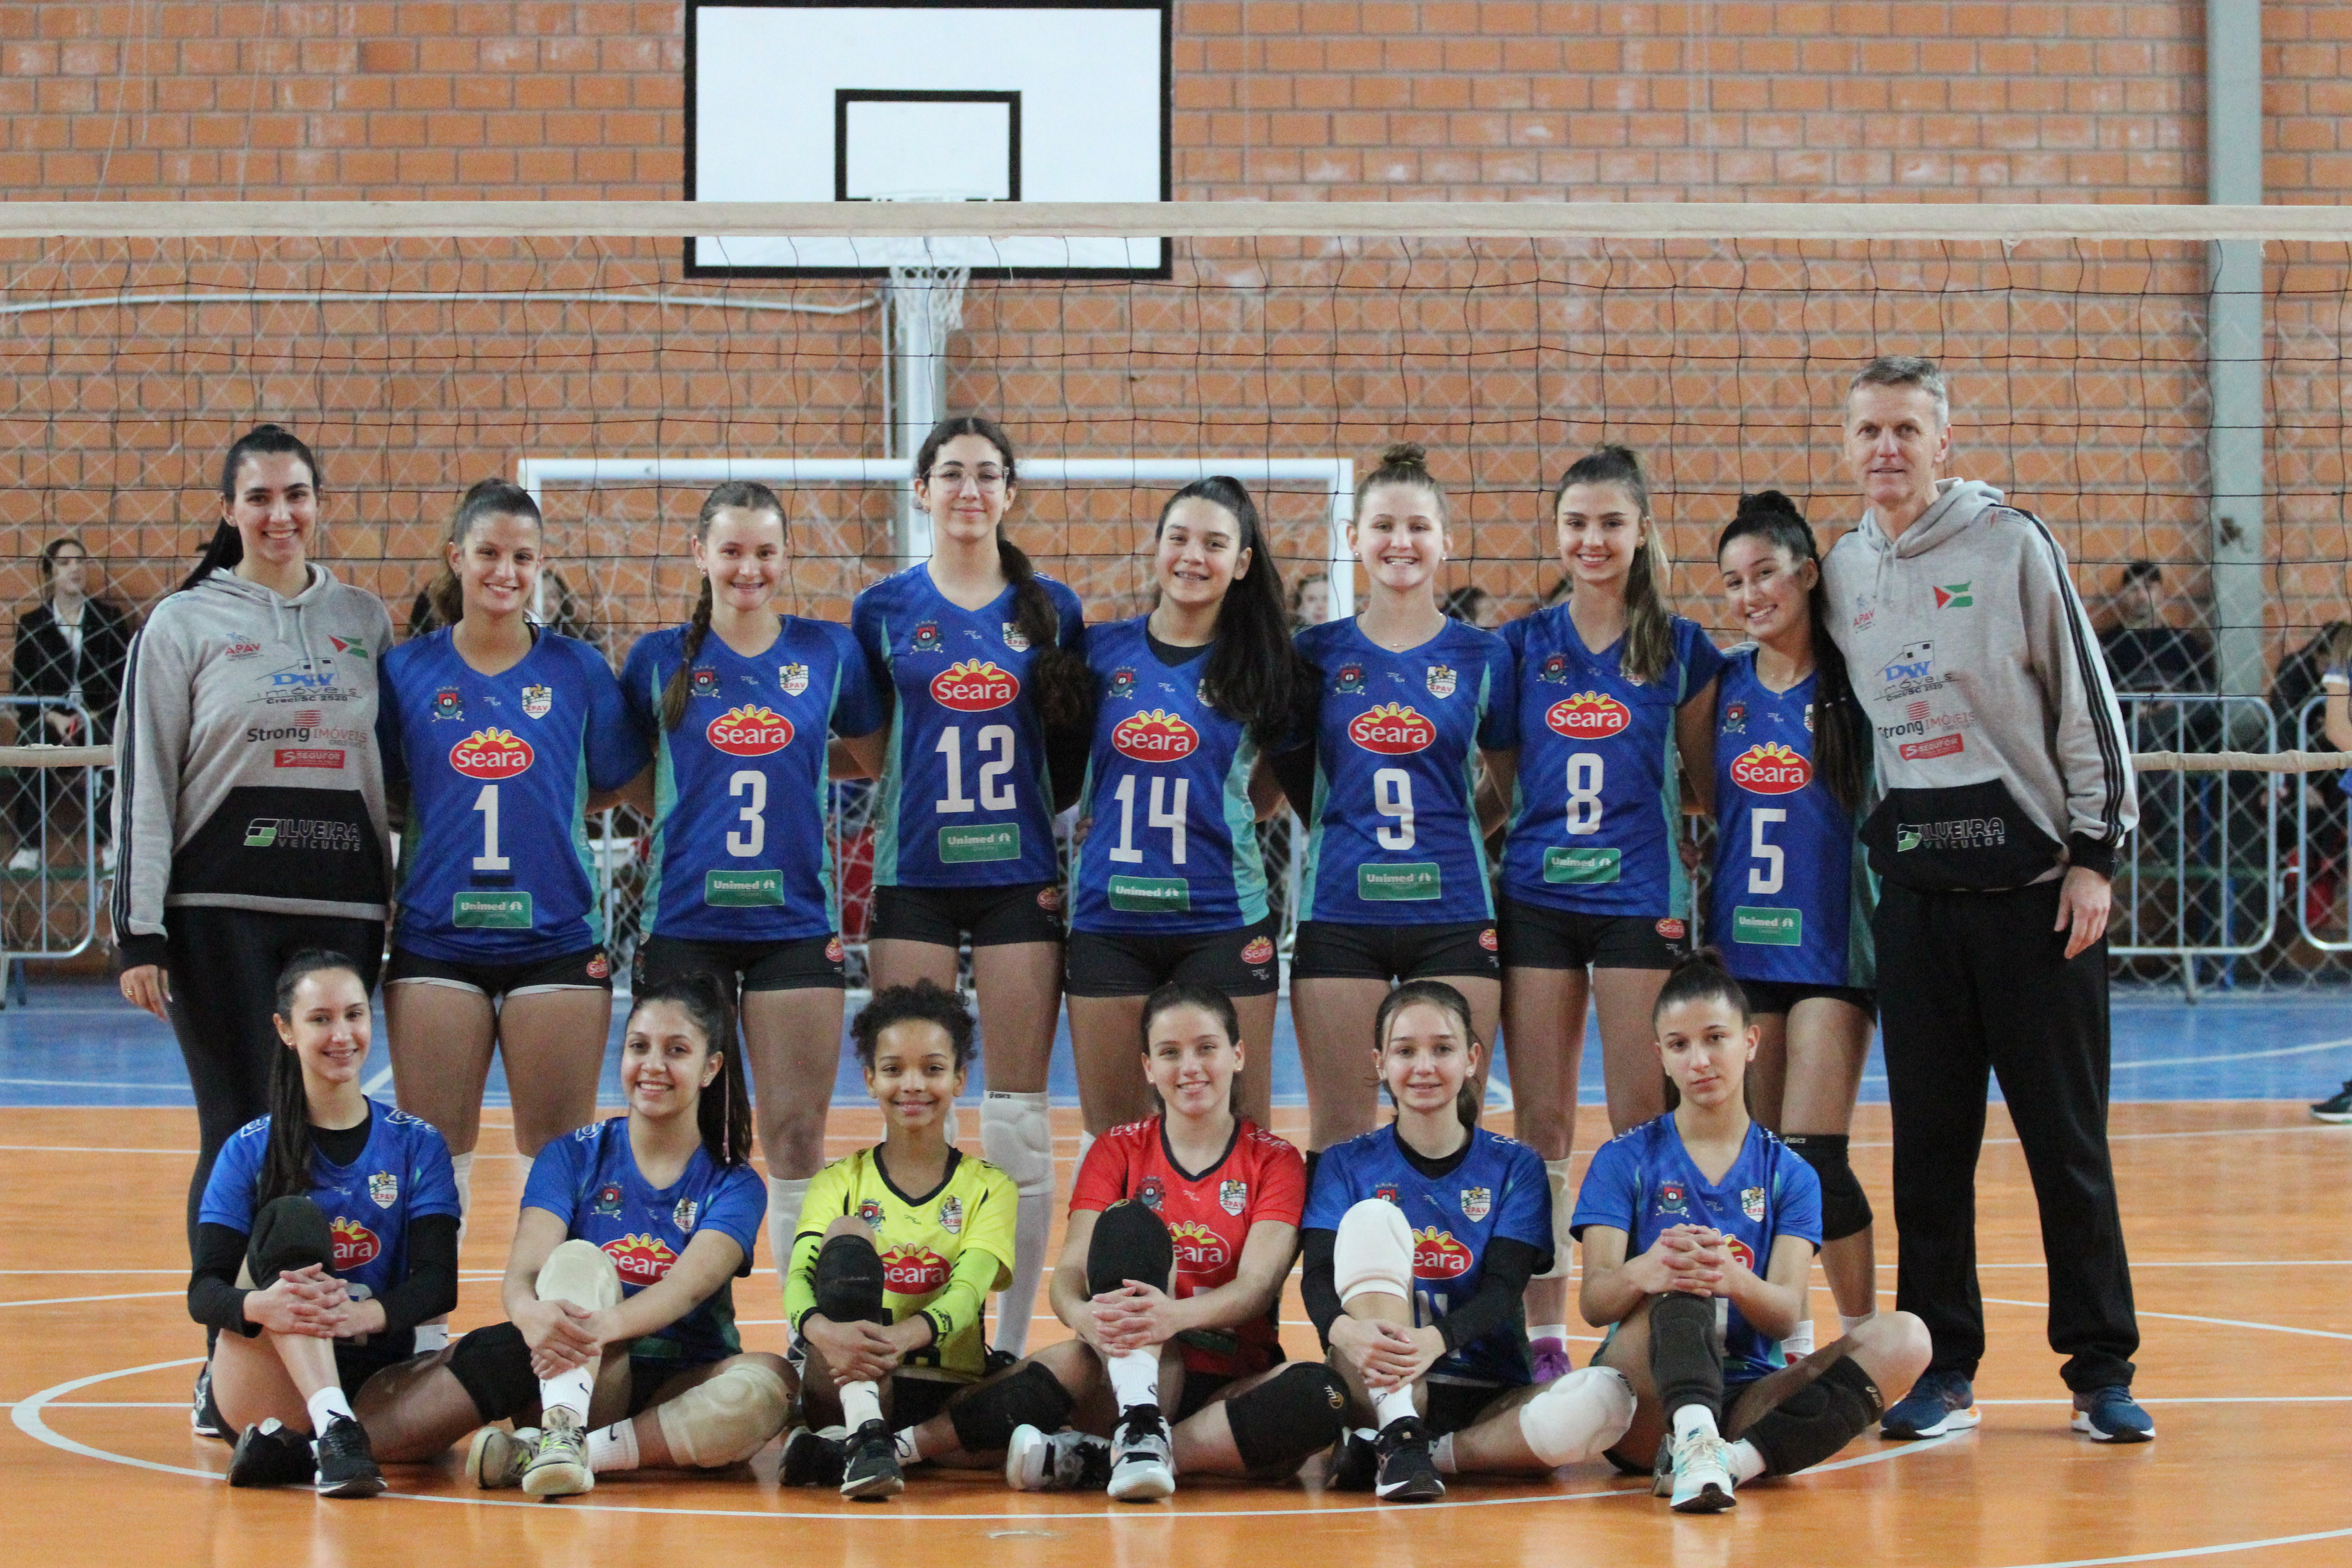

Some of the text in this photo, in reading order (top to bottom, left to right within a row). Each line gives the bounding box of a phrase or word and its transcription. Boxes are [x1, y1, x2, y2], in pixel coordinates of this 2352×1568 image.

[225, 643, 261, 655] APAV
[936, 681, 1011, 700] Seara
[1552, 708, 1622, 727] Seara
[247, 727, 310, 742] Strong
[714, 725, 786, 744] Seara
[1117, 728, 1190, 752] Seara
[1355, 723, 1428, 744] Seara
[456, 749, 527, 767] Seara
[935, 725, 1017, 813] 12
[1735, 763, 1804, 783] Seara
[1566, 752, 1604, 835] 8
[726, 771, 767, 857] 3
[1374, 768, 1416, 850] 9
[473, 785, 510, 870] 1
[1109, 775, 1189, 864] 14
[948, 834, 995, 845] Unimed
[1748, 808, 1786, 894] 5
[714, 880, 760, 890] Unimed
[1366, 873, 1414, 883] Unimed
[1116, 885, 1161, 897] Unimed
[461, 901, 506, 910] Unimed
[1739, 916, 1778, 926] Unimed
[333, 1242, 372, 1258] ara
[1172, 1244, 1222, 1262] eara
[1413, 1251, 1464, 1270] eara
